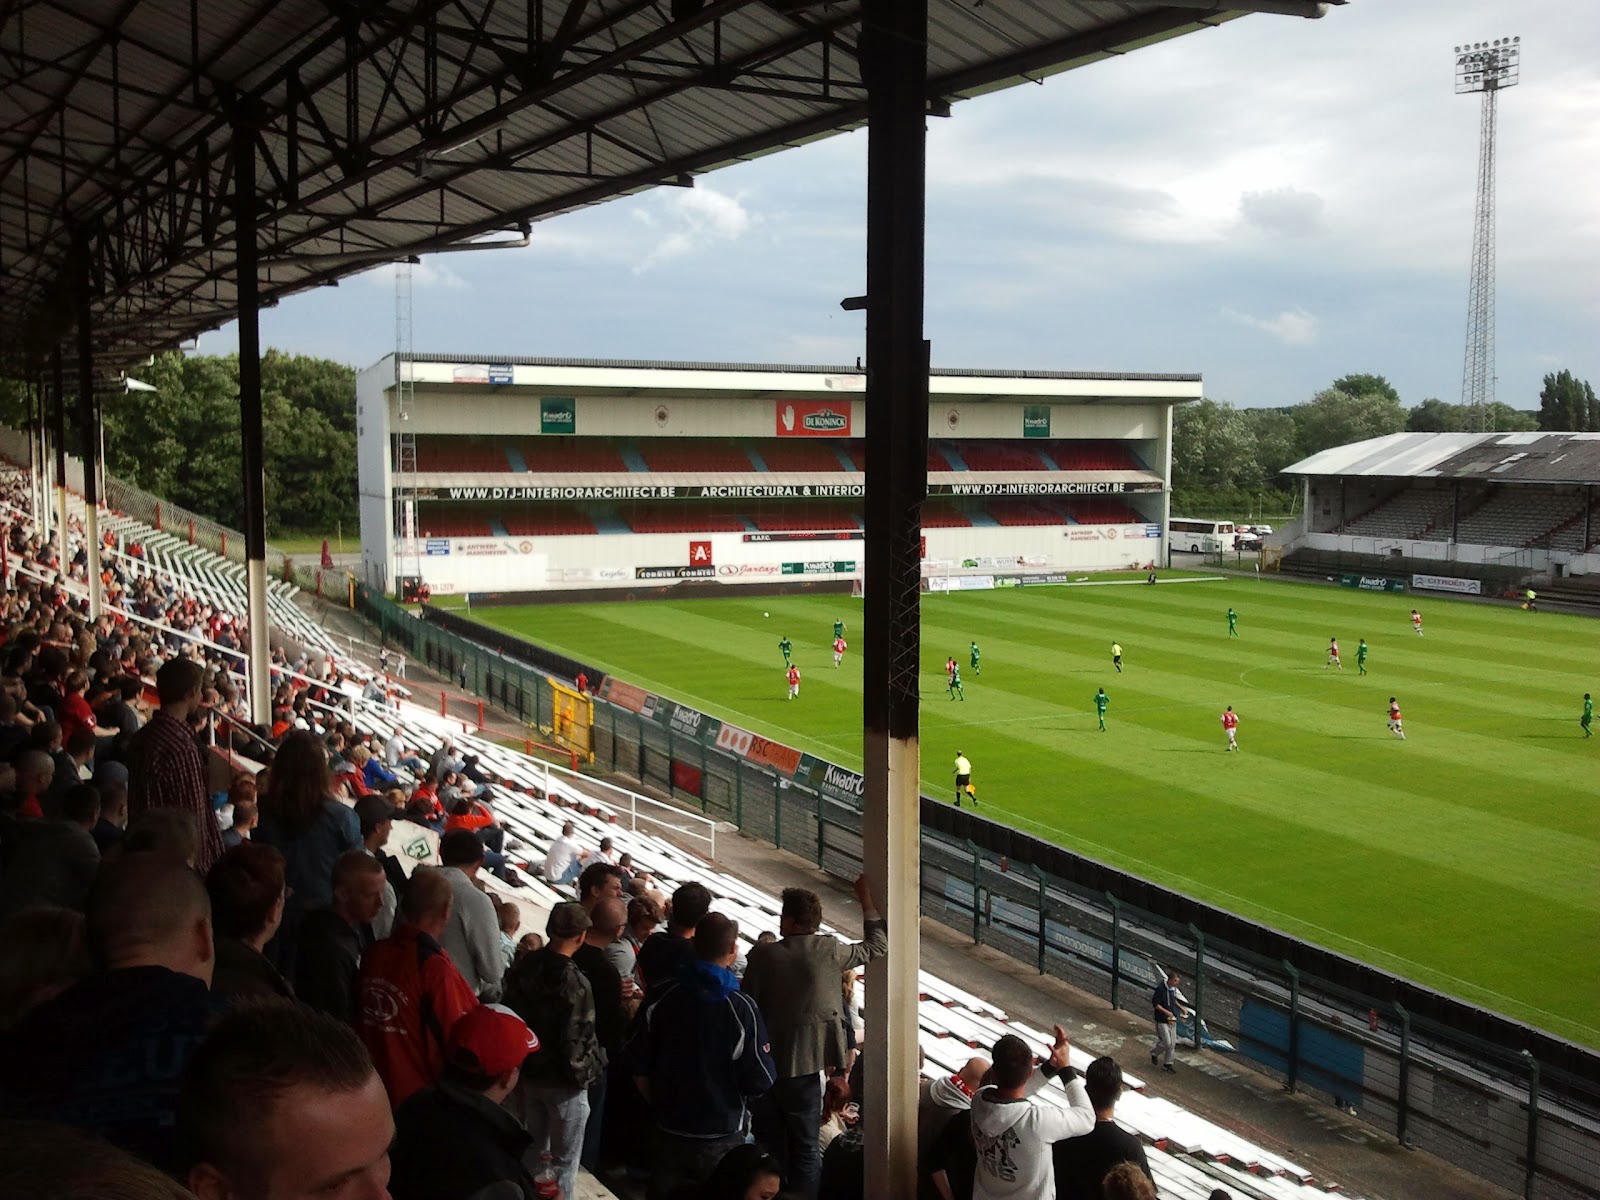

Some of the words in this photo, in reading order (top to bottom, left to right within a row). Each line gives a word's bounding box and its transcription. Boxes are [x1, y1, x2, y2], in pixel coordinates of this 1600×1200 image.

[805, 417, 815, 427] DE
[814, 416, 846, 428] KONINCK
[450, 486, 675, 499] WWW.DTJ-INTERIORARCHITECT.BE
[701, 485, 799, 497] ARCHITECTURAL
[802, 485, 813, 497] &
[951, 482, 1125, 495] WWW.DTJ-INTERIORARCHITECT.BE
[694, 545, 708, 561] A
[750, 735, 771, 757] RSC
